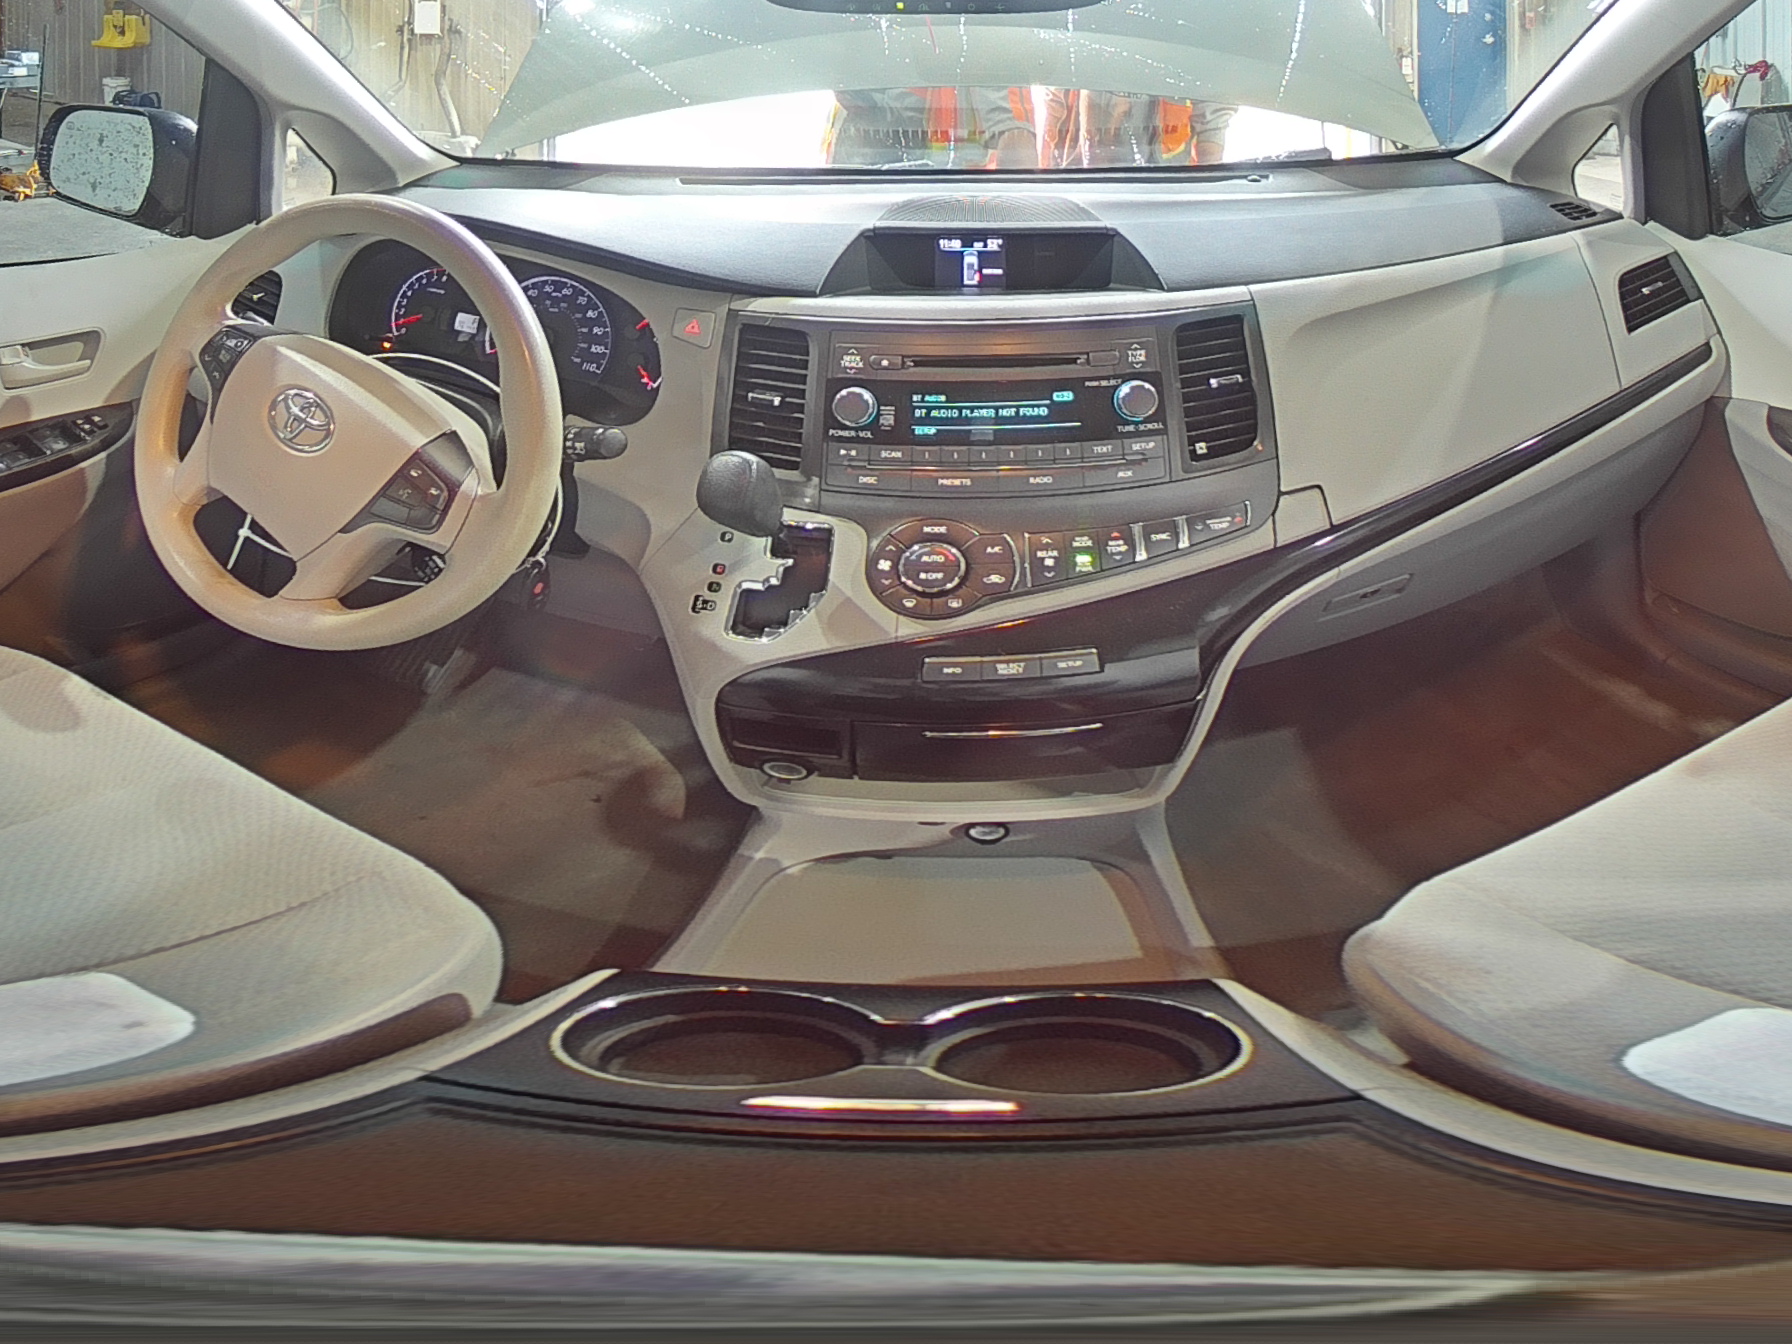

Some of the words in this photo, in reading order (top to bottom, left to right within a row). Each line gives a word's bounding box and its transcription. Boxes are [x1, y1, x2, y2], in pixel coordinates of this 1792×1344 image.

[543, 284, 554, 293] 50
[561, 287, 573, 296] 60
[576, 296, 588, 305] 70
[586, 310, 598, 318] 80
[592, 326, 604, 335] 90
[590, 344, 605, 354] 100
[582, 362, 597, 372] 110
[840, 360, 864, 368] TRACK
[912, 394, 922, 402] BT
[914, 409, 927, 418] BT
[930, 409, 959, 418] AUDIO
[962, 408, 996, 418] PLAYER
[998, 408, 1017, 417] NOT
[1019, 408, 1049, 417] FOUND
[1093, 445, 1113, 454] TEXT
[1131, 441, 1156, 451] SETUP
[880, 450, 902, 458] SCAN
[1117, 470, 1134, 478] AUX
[859, 476, 878, 484] DISC
[938, 478, 972, 486] PRESETS
[1029, 476, 1053, 484] RADIO
[923, 525, 948, 534] MODE
[1150, 532, 1172, 542] SYNC
[986, 546, 1003, 554] A/C
[1036, 549, 1058, 558] REAR
[1107, 545, 1128, 554] TEMP
[921, 555, 945, 563] AUTO
[928, 572, 945, 580] OFF
[1057, 660, 1083, 668] SETUP
[943, 667, 962, 675] INFO
